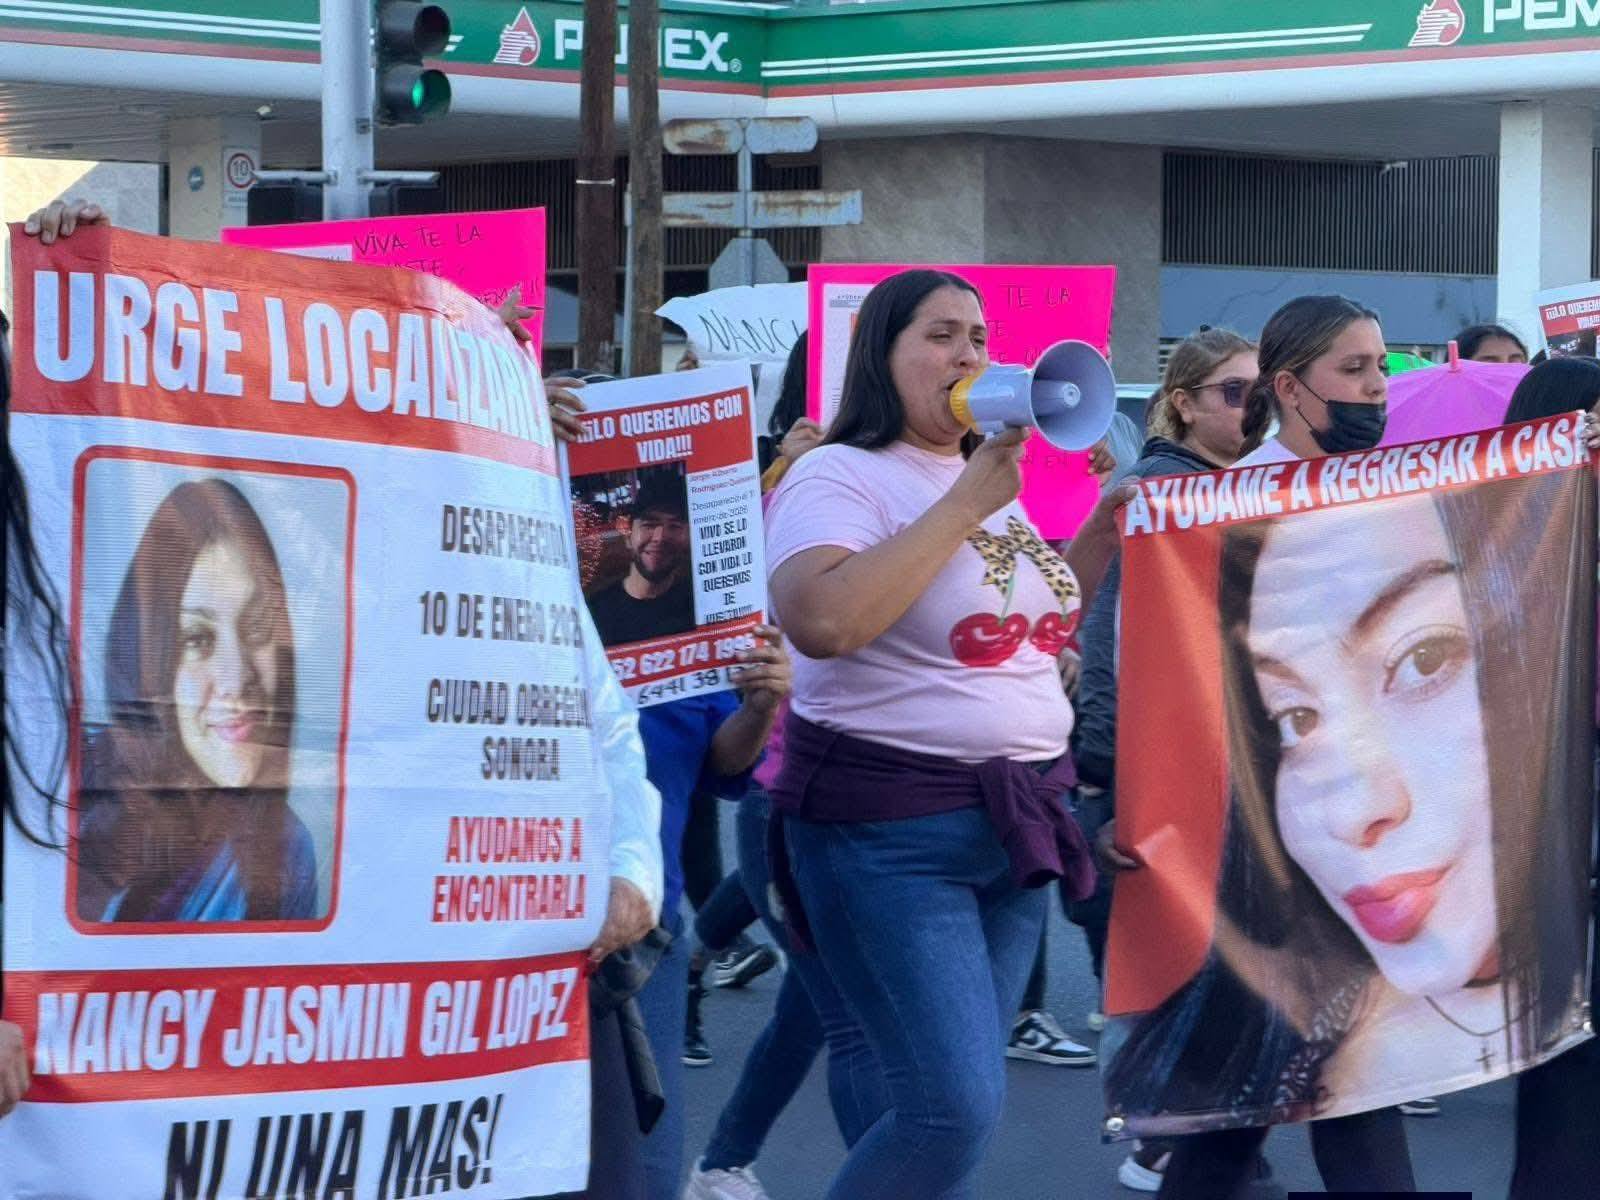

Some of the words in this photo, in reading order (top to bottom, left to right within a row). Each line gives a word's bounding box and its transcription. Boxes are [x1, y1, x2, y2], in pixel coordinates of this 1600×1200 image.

[416, 226, 440, 248] TE
[456, 222, 482, 245] LA
[33, 269, 244, 398] URGE
[619, 402, 712, 437] QUEREMOS
[713, 393, 743, 421] CON
[636, 433, 694, 464] VIDA!!!
[1124, 463, 1287, 537] AYUDAME
[1290, 461, 1313, 510] A
[1319, 433, 1480, 506] REGRESAR
[1485, 430, 1508, 479] A
[702, 535, 747, 558] LLEVARON
[724, 520, 736, 535] SE
[737, 517, 748, 532] LO
[699, 560, 718, 576] CON
[720, 555, 741, 571] VIDA
[703, 569, 752, 593] QUEREMOS
[420, 590, 447, 636] 10
[456, 593, 484, 639] DE
[492, 596, 545, 644] ENERO
[723, 591, 736, 606] DE
[427, 678, 509, 725] CIUDAD
[481, 736, 560, 781] SONORA
[569, 816, 583, 863] A
[431, 873, 586, 923] ENCONTRARLA
[33, 988, 217, 1076] NANCY
[222, 981, 412, 1068] JASMIN
[418, 979, 483, 1058] GIL
[486, 966, 580, 1052] LOPEZ
[163, 1119, 233, 1200] NI
[244, 1109, 366, 1200] UNA
[376, 1093, 503, 1200] MAS!
